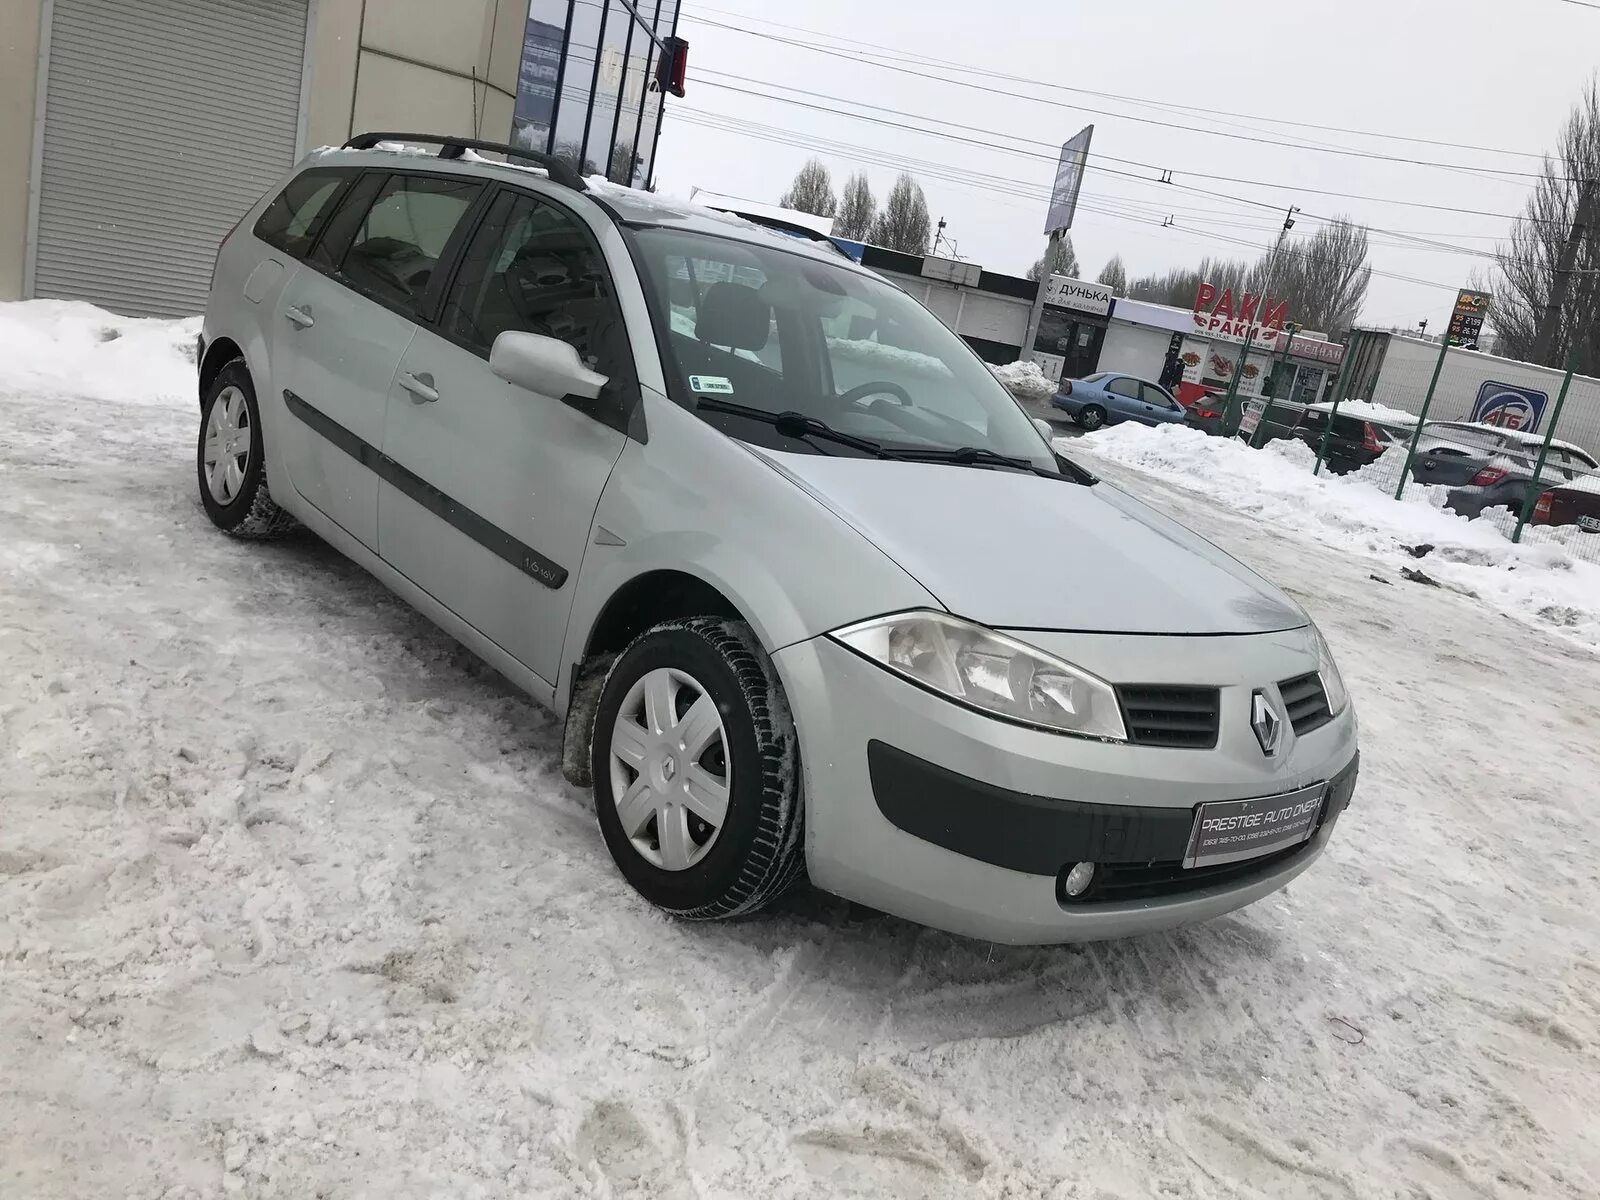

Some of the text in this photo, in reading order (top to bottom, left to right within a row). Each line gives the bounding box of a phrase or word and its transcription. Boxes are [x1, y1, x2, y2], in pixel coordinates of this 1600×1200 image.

[1059, 284, 1109, 303] ДУНЬКА
[1193, 283, 1288, 330] РАКИ
[1580, 515, 1593, 528] AE
[1202, 813, 1264, 832] PRESTIGE
[1264, 807, 1293, 824] AUTO
